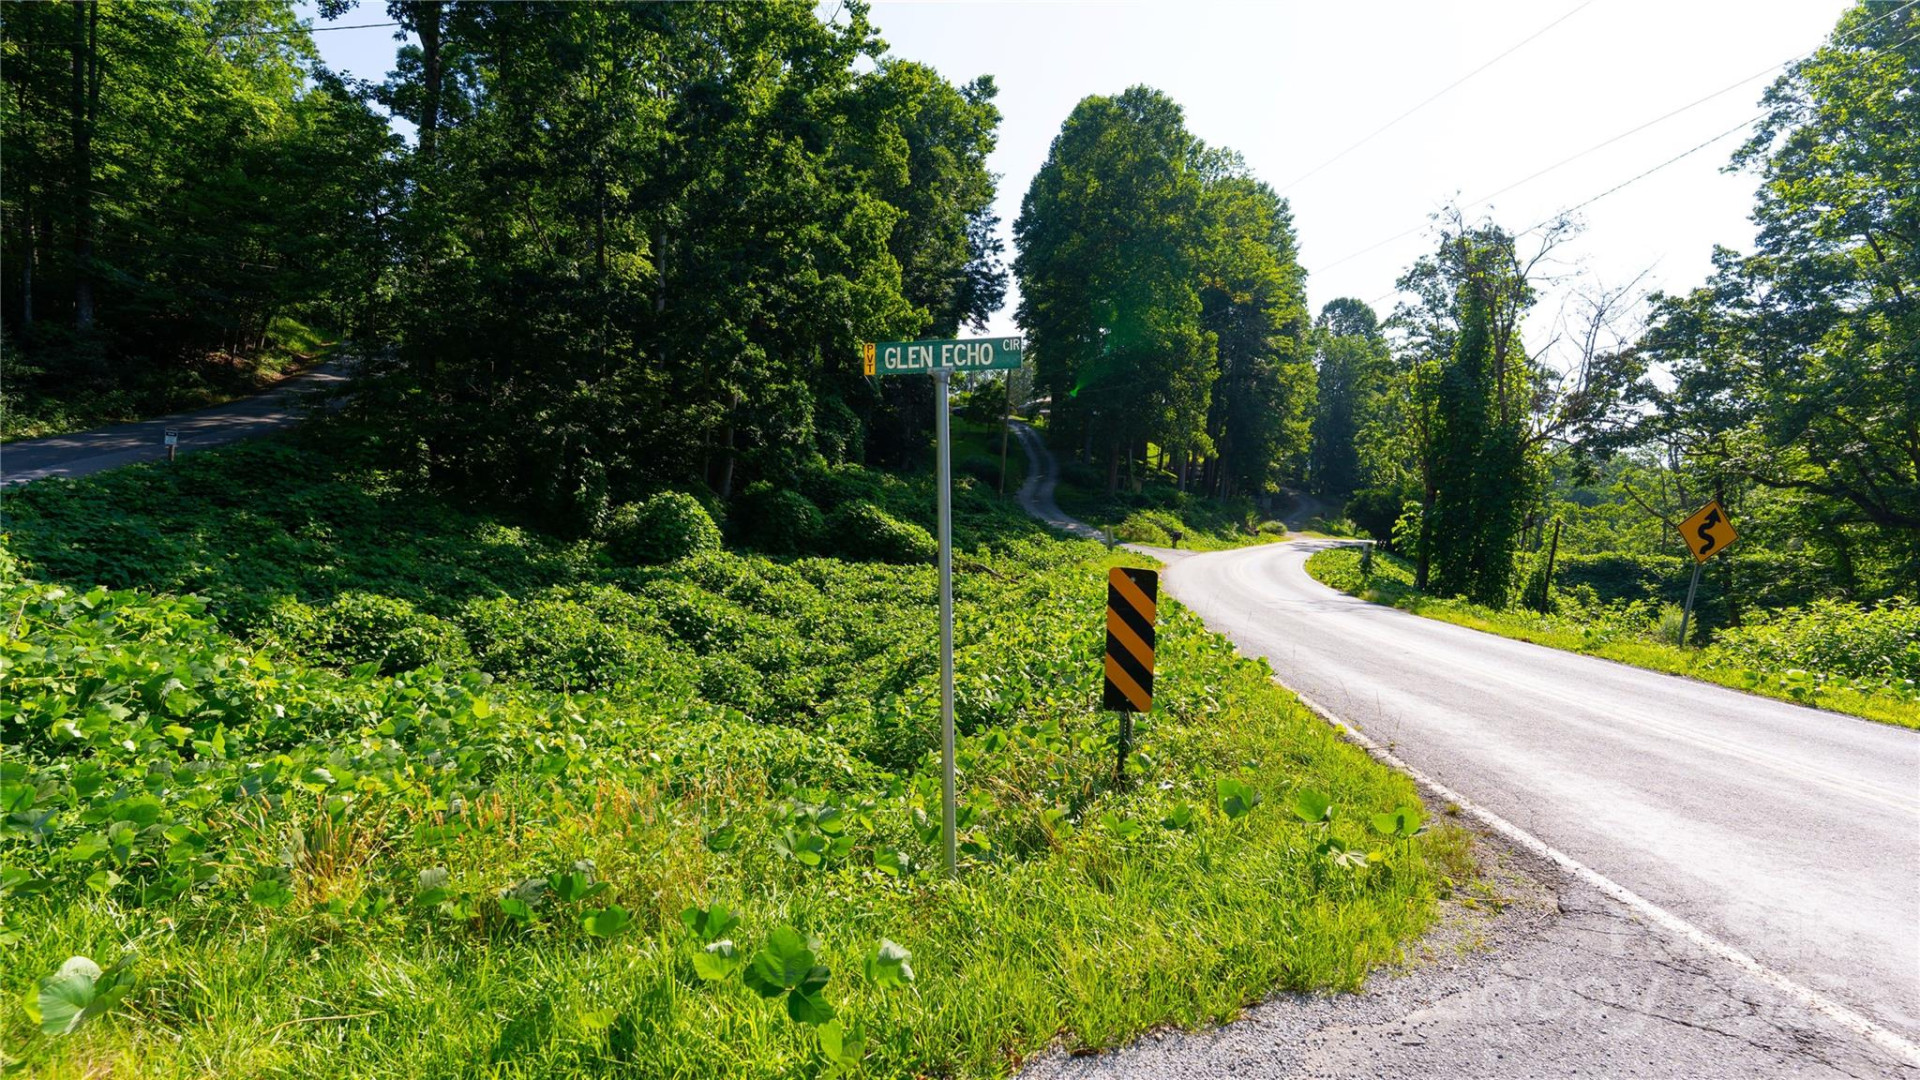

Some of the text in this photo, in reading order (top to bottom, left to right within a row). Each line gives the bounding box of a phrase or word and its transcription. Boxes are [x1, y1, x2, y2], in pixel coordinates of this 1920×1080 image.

[866, 344, 874, 373] PVT
[884, 338, 1020, 369] GLEN ECHO CIR
